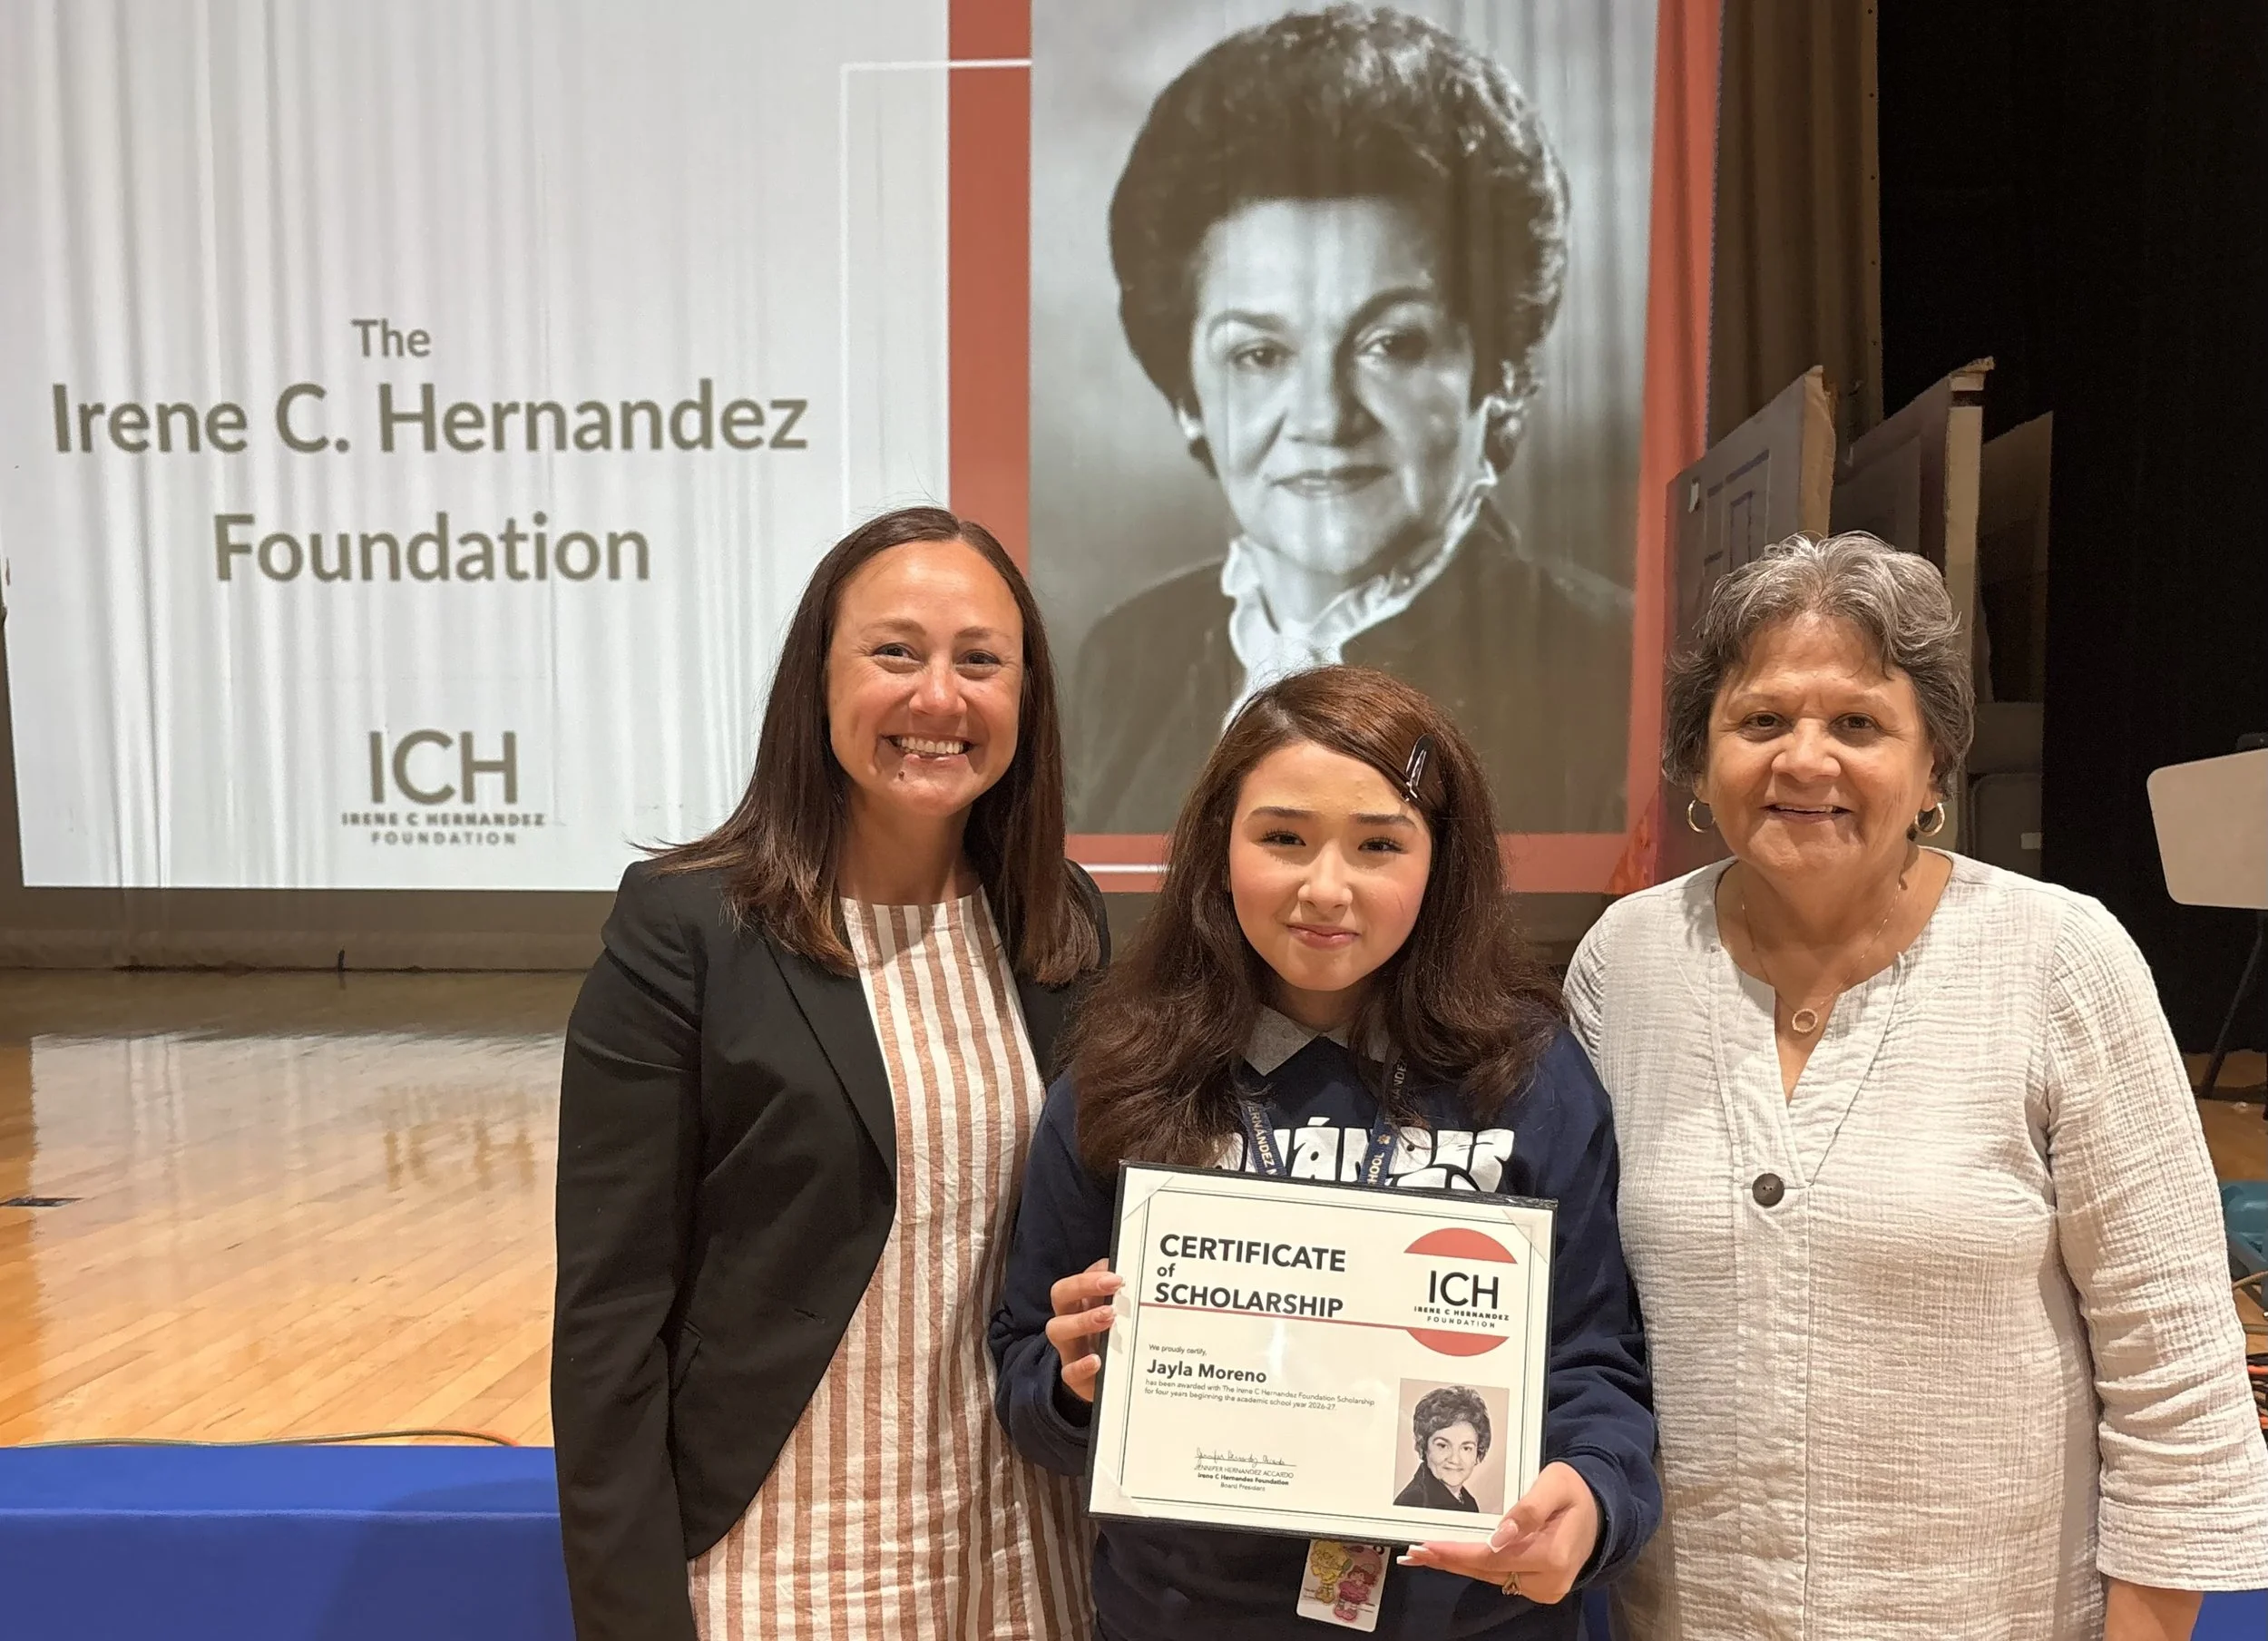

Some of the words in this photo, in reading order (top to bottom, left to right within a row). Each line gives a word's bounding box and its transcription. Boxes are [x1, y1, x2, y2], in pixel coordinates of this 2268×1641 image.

[351, 319, 431, 357] The
[52, 383, 248, 454] Irene
[276, 382, 350, 453] C.
[377, 377, 808, 452] Hernandez
[213, 511, 650, 582] Foundation
[369, 728, 517, 806] ICH
[341, 813, 397, 826] IRENE
[407, 813, 418, 826] C
[426, 813, 545, 826] HERNANDEZ
[371, 831, 516, 845] FOUNDATION
[1367, 1152, 1384, 1184] HOOL
[1159, 1234, 1346, 1272] CERTIFICATE
[1157, 1263, 1176, 1277] of
[1154, 1282, 1344, 1317] SCHOLARSHIP
[1429, 1270, 1499, 1309] ICH
[1414, 1306, 1441, 1314] IRENE
[1453, 1310, 1510, 1321] HERNANDEZ
[1427, 1315, 1495, 1328] FOUNDATION
[1161, 1345, 1185, 1354] proudly
[1147, 1359, 1193, 1379] Jayla
[1198, 1363, 1266, 1383] Moreno
[1145, 1378, 1157, 1386] has
[1158, 1379, 1176, 1387] been
[1178, 1382, 1206, 1390] awarded
[1207, 1383, 1220, 1392] with
[1261, 1389, 1296, 1398] Hernandez
[1298, 1392, 1335, 1402] Foundation
[1337, 1395, 1375, 1407] Scholarship
[1170, 1390, 1188, 1398] years
[1189, 1391, 1223, 1402] beginning
[1237, 1396, 1268, 1404] academic
[1225, 1467, 1262, 1476] HERNANDEZ
[1255, 1477, 1289, 1485] Foundation
